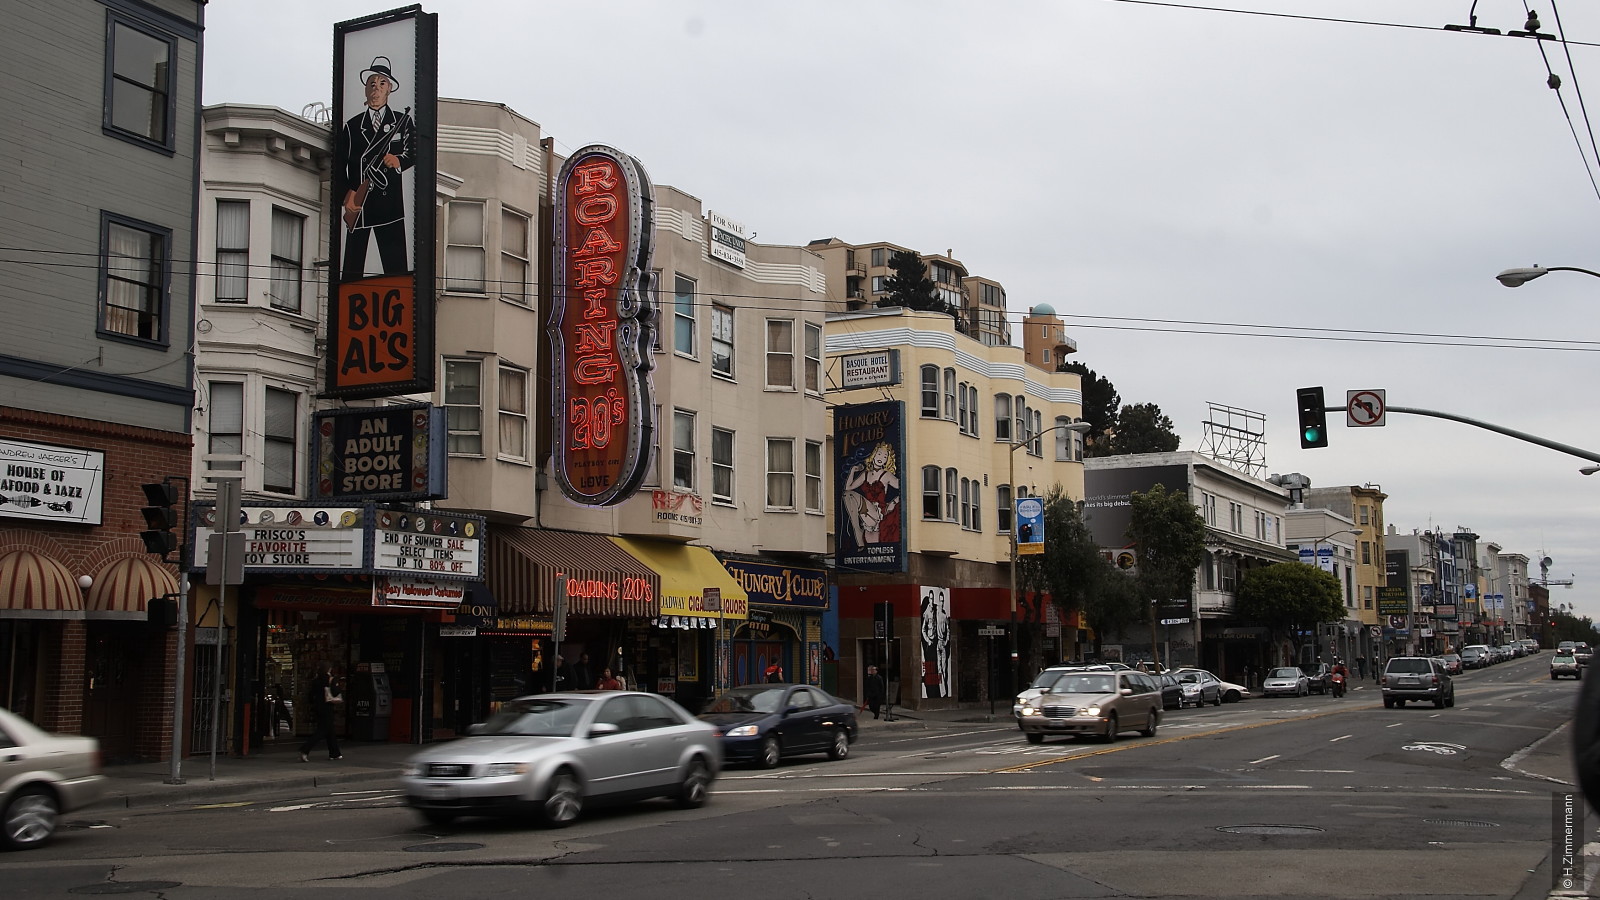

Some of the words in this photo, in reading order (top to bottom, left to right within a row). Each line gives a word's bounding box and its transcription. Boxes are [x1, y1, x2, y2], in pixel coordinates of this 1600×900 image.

[713, 214, 726, 227] FOR
[727, 221, 744, 235] SALE
[571, 162, 622, 385] ROARING
[347, 289, 405, 331] BIG
[341, 330, 409, 376] AL'S
[846, 358, 868, 369] BASQUE
[871, 355, 888, 366] HOTEL
[846, 366, 888, 377] RESTAURANT
[359, 418, 388, 435] AN
[839, 410, 894, 431] HUNGRY
[344, 435, 403, 455] ADULT
[851, 427, 885, 446] CLUB
[38, 453, 78, 465] JAEGER'S
[344, 454, 401, 474] BOOK
[7, 464, 46, 481] HOUSE
[50, 469, 66, 482] OF
[580, 475, 610, 488] LOVE
[0, 479, 40, 494] AFOOD
[43, 483, 52, 495] &
[55, 484, 83, 499] JAZZ
[342, 473, 403, 493] STORE
[657, 512, 679, 521] ROOMS
[254, 530, 306, 540] FRISCO'S
[384, 533, 399, 544] END
[403, 534, 413, 545] OF
[415, 536, 443, 548] SUMMER
[447, 539, 464, 550] SALE
[250, 542, 307, 552] FAVORITE
[400, 546, 426, 558] SELECT
[433, 549, 454, 560] ITEMS
[867, 546, 894, 554] TOPLESS
[272, 553, 310, 564] STORE
[396, 557, 407, 568] UP
[413, 558, 424, 569] TO
[429, 560, 446, 571] 80%
[451, 561, 463, 572] OFF
[843, 555, 896, 565] ENTERTAINMENT
[556, 574, 618, 600] OARING
[729, 567, 786, 600] HUNGRY
[782, 569, 792, 601] I
[792, 574, 825, 600] CLUB
[723, 599, 746, 614] IQUORS
